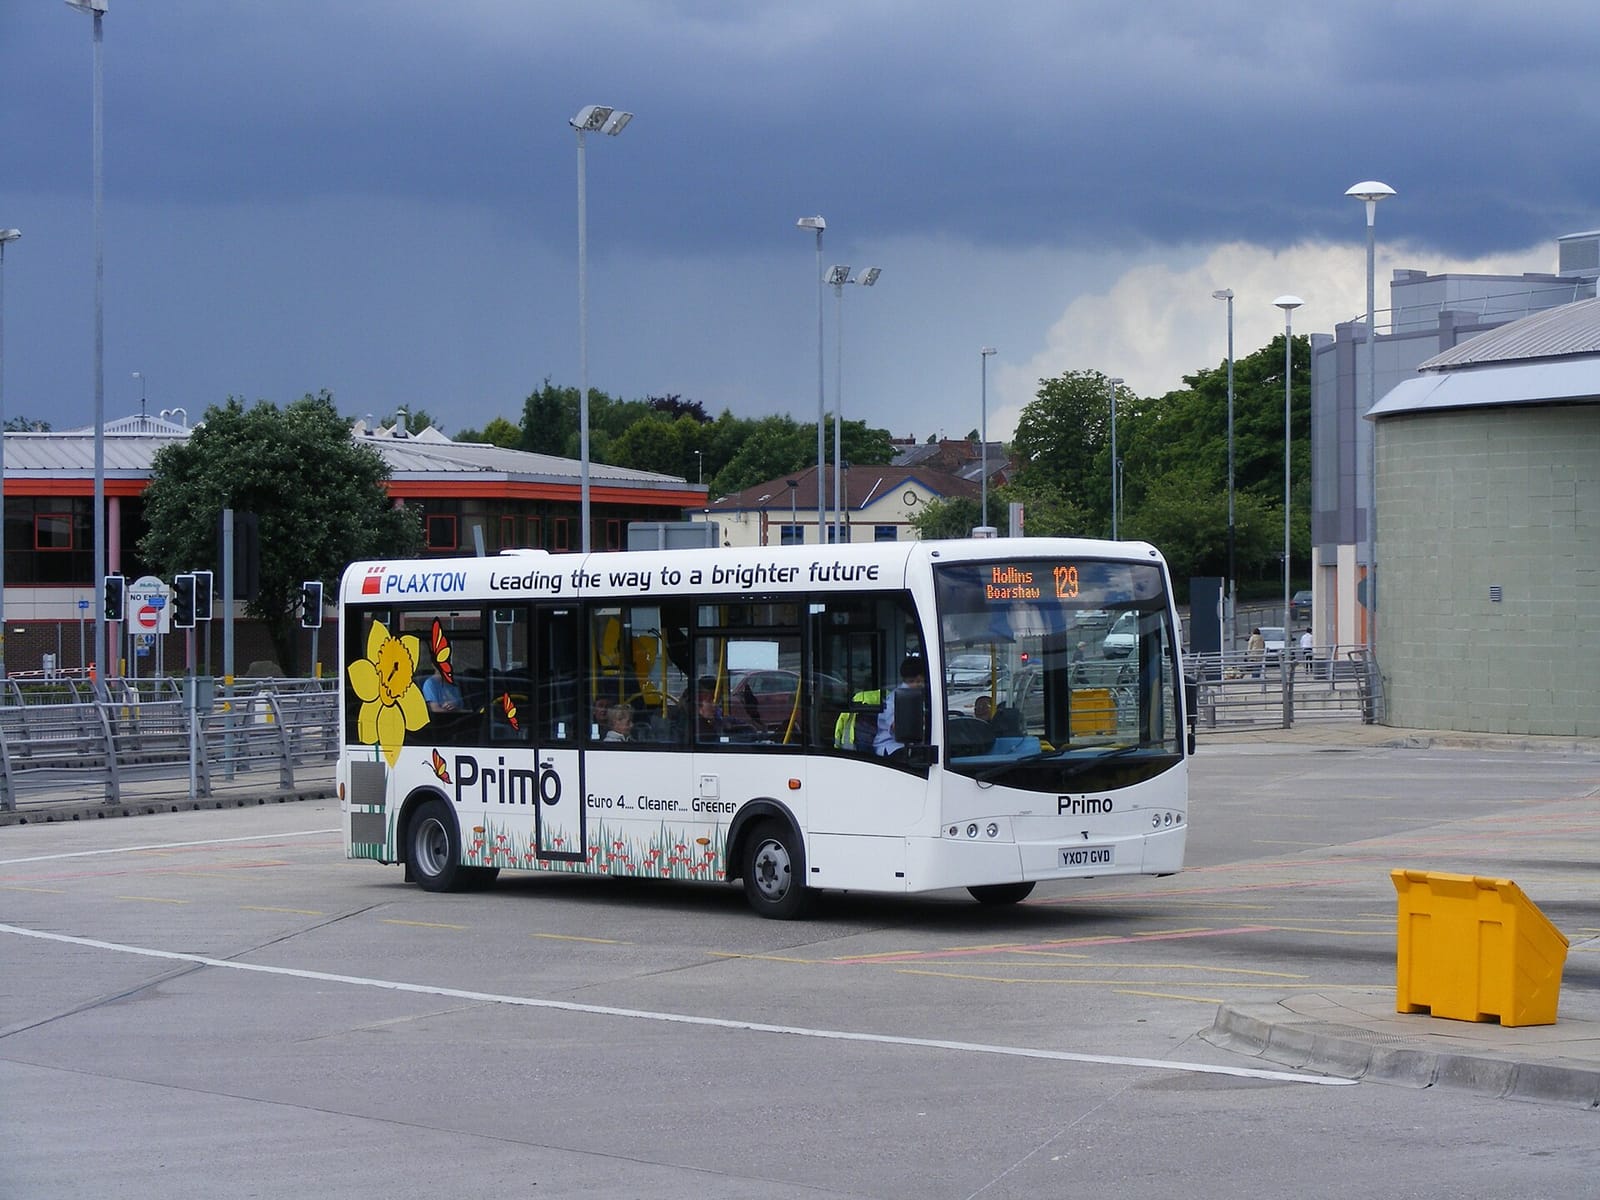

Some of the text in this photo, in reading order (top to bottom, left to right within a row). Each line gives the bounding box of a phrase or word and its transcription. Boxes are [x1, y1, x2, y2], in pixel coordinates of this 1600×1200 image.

[386, 572, 466, 594] PLAXTON
[490, 561, 879, 593] Leading the way to a brighter future
[992, 566, 1033, 584] Hollins
[1053, 566, 1079, 598] 129
[986, 584, 1040, 599] Boarshaw
[455, 755, 562, 806] Primo
[587, 793, 613, 809] Euro
[691, 797, 737, 814] Greener
[1057, 795, 1114, 815] Primo
[1062, 849, 1111, 865] YX07 GVD
